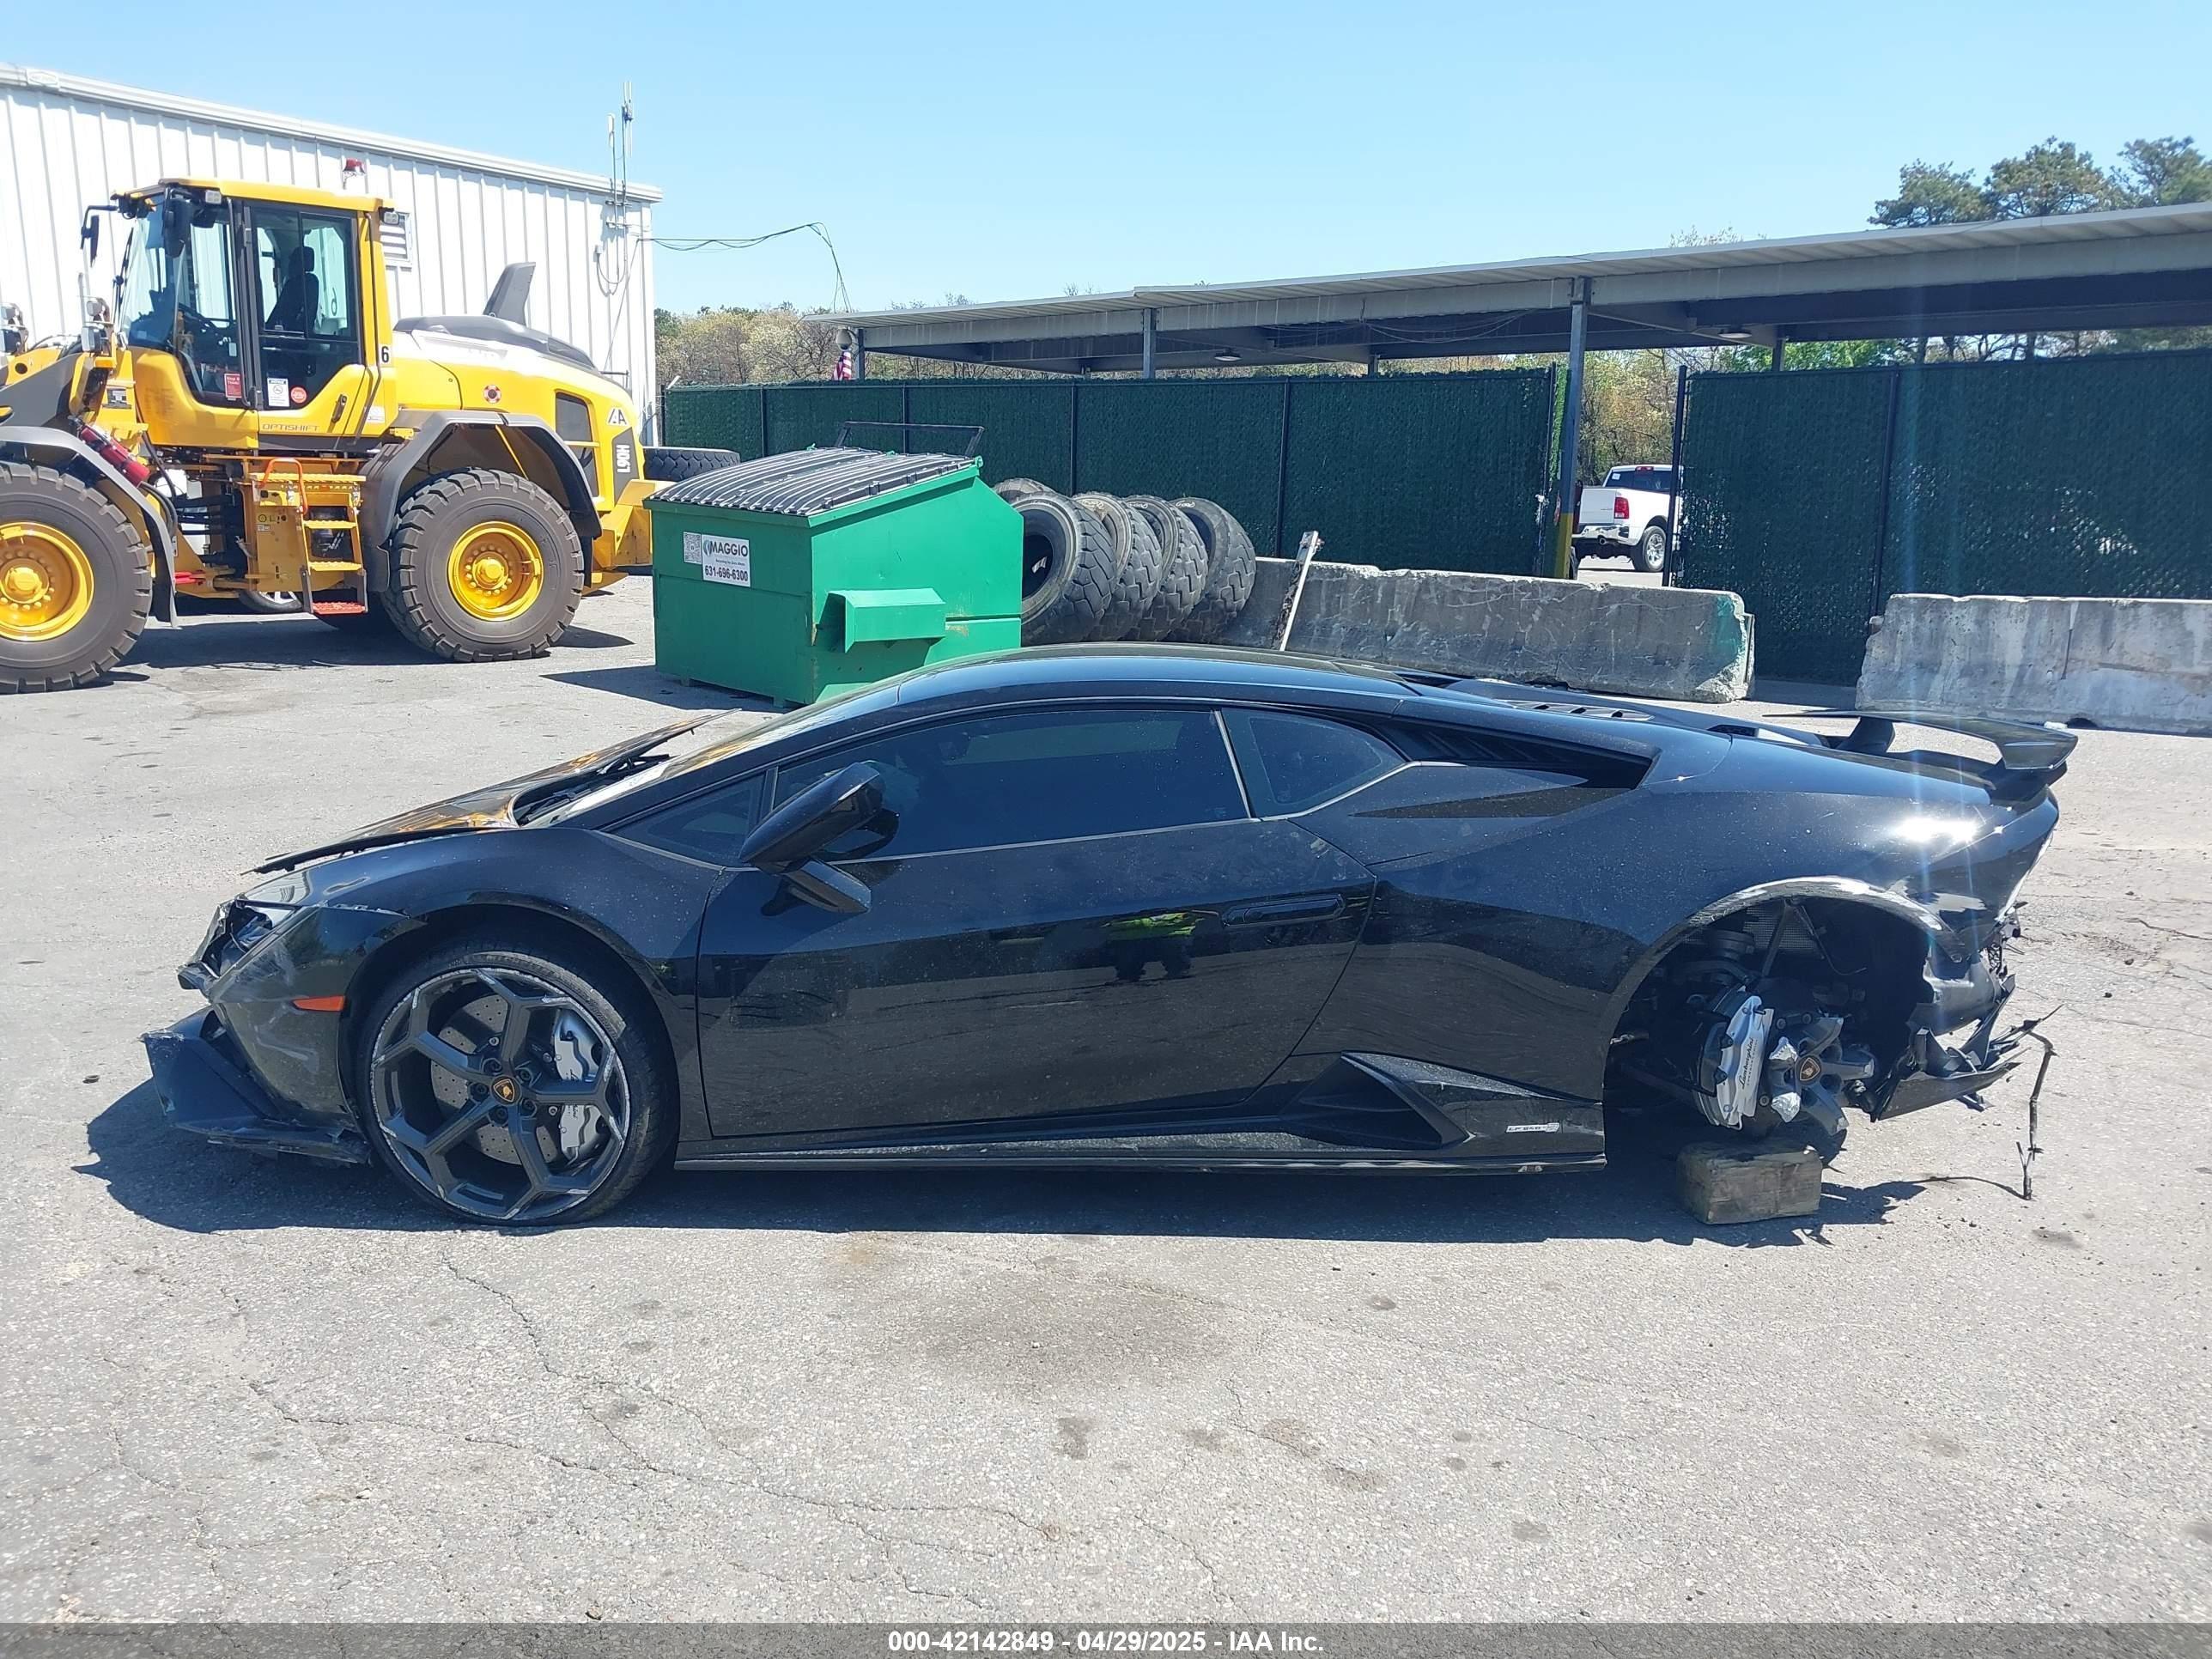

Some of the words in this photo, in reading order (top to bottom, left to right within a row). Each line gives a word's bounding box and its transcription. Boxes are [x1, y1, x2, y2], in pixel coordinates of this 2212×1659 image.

[380, 345, 390, 363] 6
[616, 444, 631, 473] L90H
[710, 540, 749, 557] MAGGIO
[704, 565, 749, 582] 631-696-6300
[1738, 1036, 1754, 1090] Lamborghini
